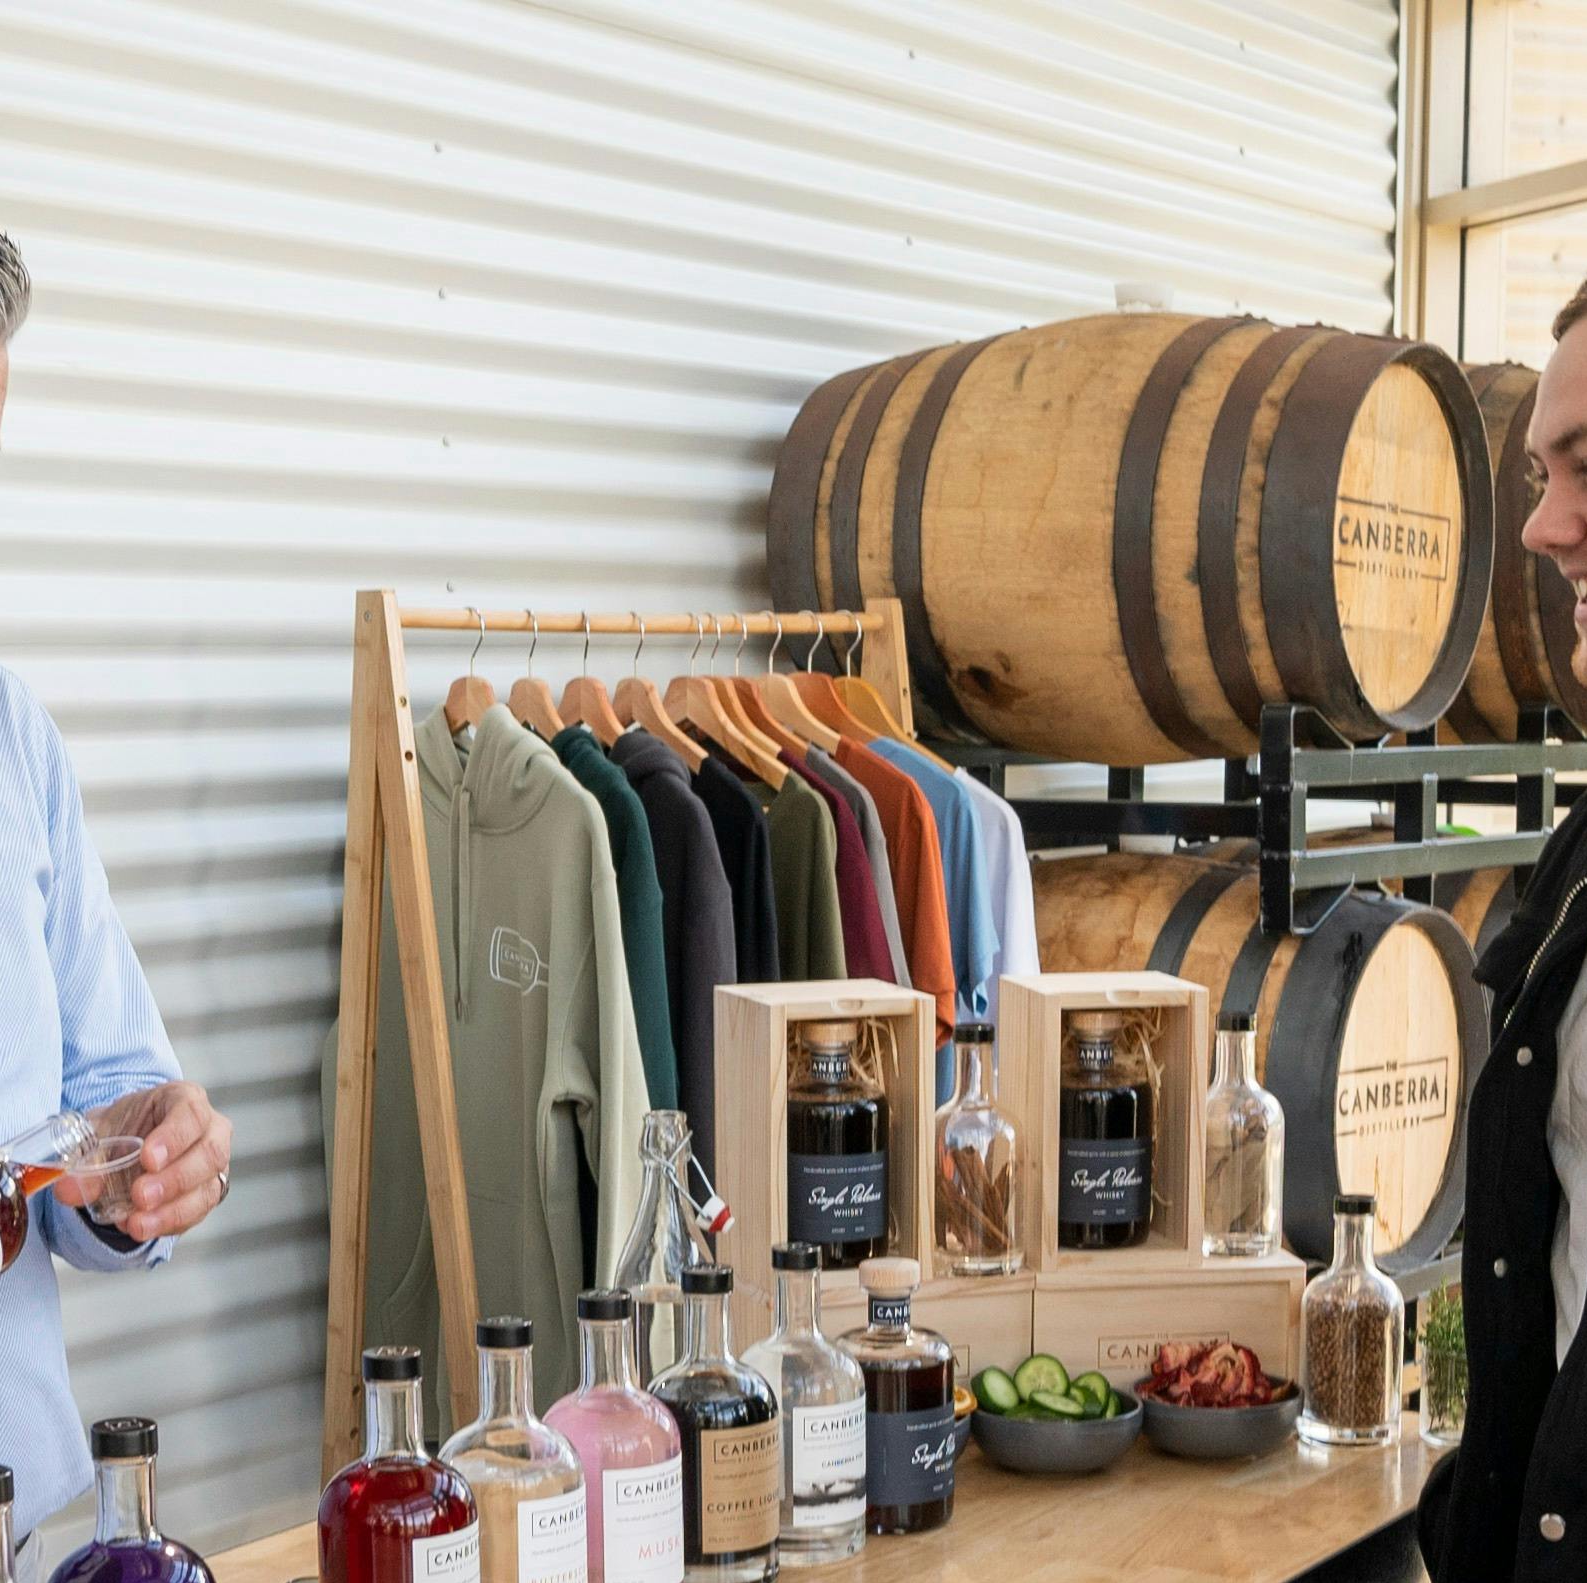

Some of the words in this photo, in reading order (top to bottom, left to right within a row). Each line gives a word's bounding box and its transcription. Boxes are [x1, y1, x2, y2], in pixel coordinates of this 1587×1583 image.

[1338, 515, 1440, 562] CANBERRA
[1359, 561, 1420, 580] DISTILLERY
[1339, 1074, 1439, 1116] CANBERRA
[1359, 1116, 1420, 1137] DISTILLERY
[1071, 1168, 1110, 1194] Single
[808, 1186, 849, 1212] Single
[1095, 1190, 1125, 1200] WHISKY
[833, 1207, 864, 1218] WHISKY
